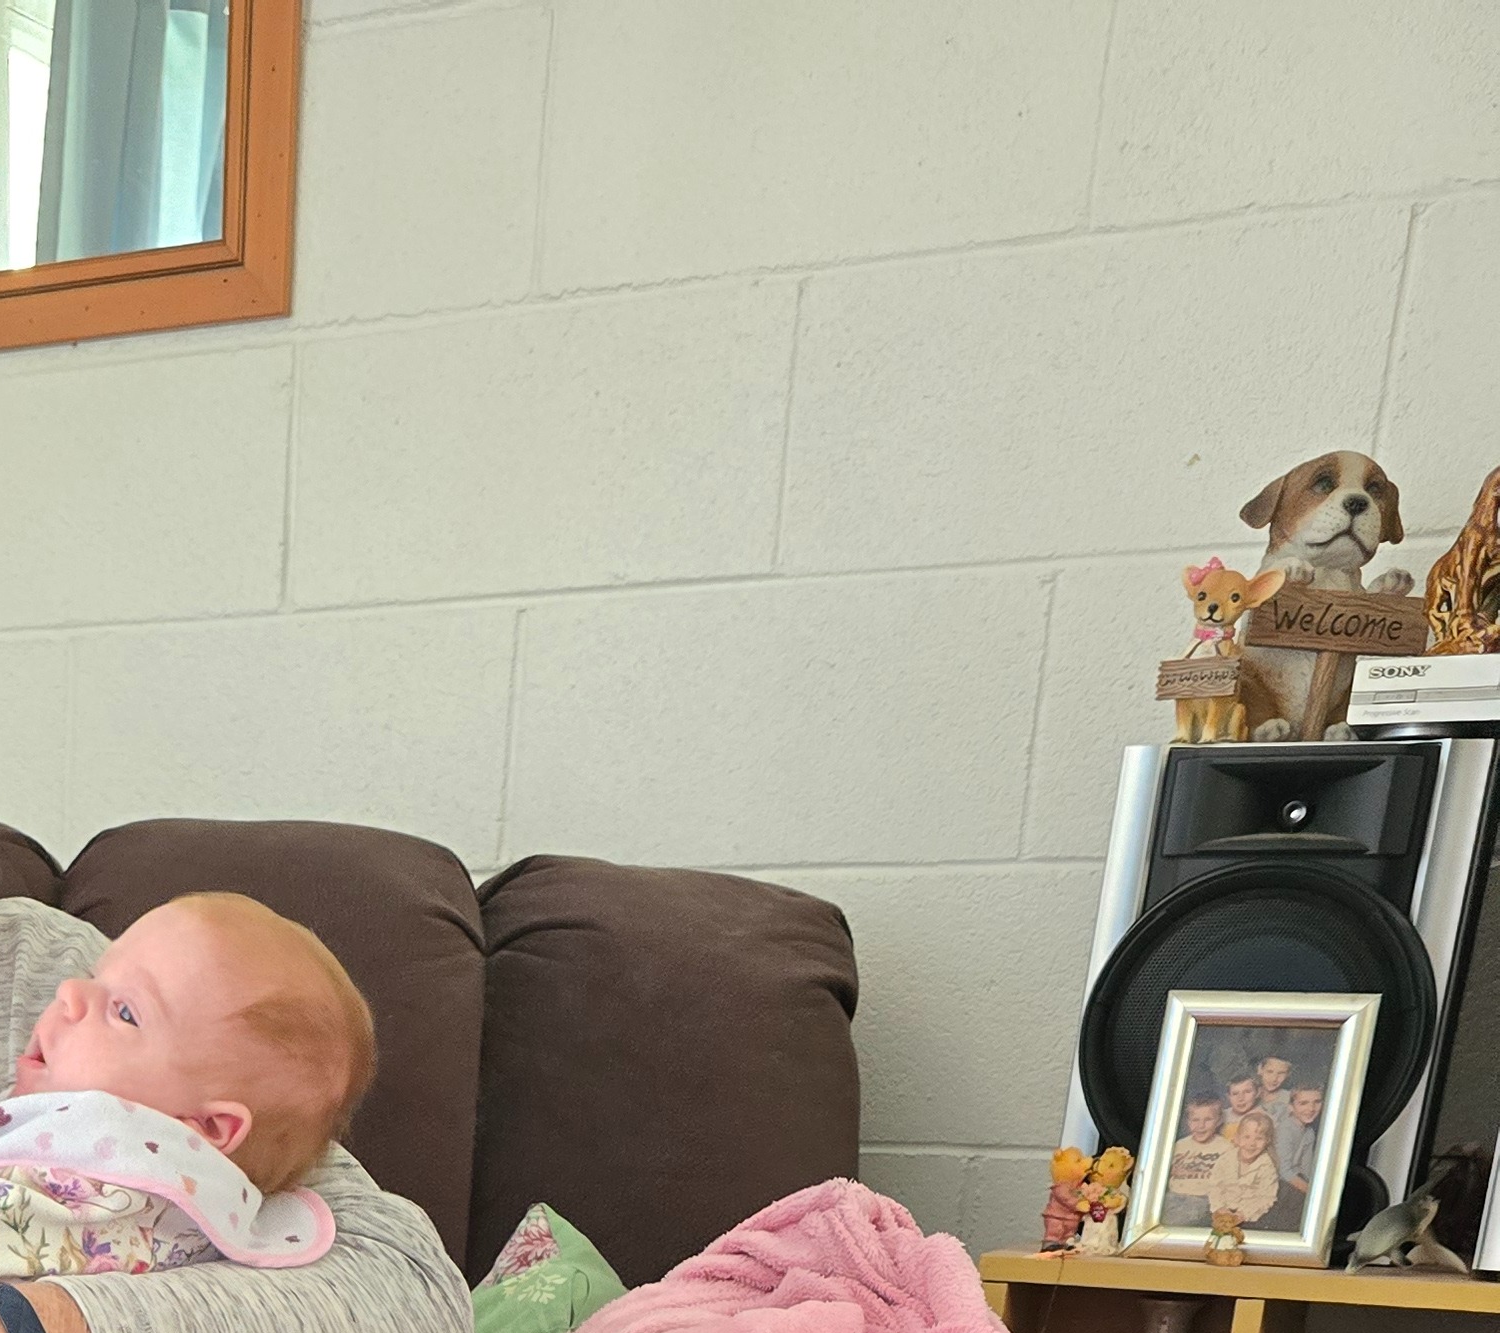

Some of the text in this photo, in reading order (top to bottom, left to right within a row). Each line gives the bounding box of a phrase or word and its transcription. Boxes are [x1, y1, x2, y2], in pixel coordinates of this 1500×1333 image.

[1270, 599, 1403, 640] Welcome
[1368, 665, 1431, 679] SONY
[1363, 707, 1421, 718] Progressive Scan
